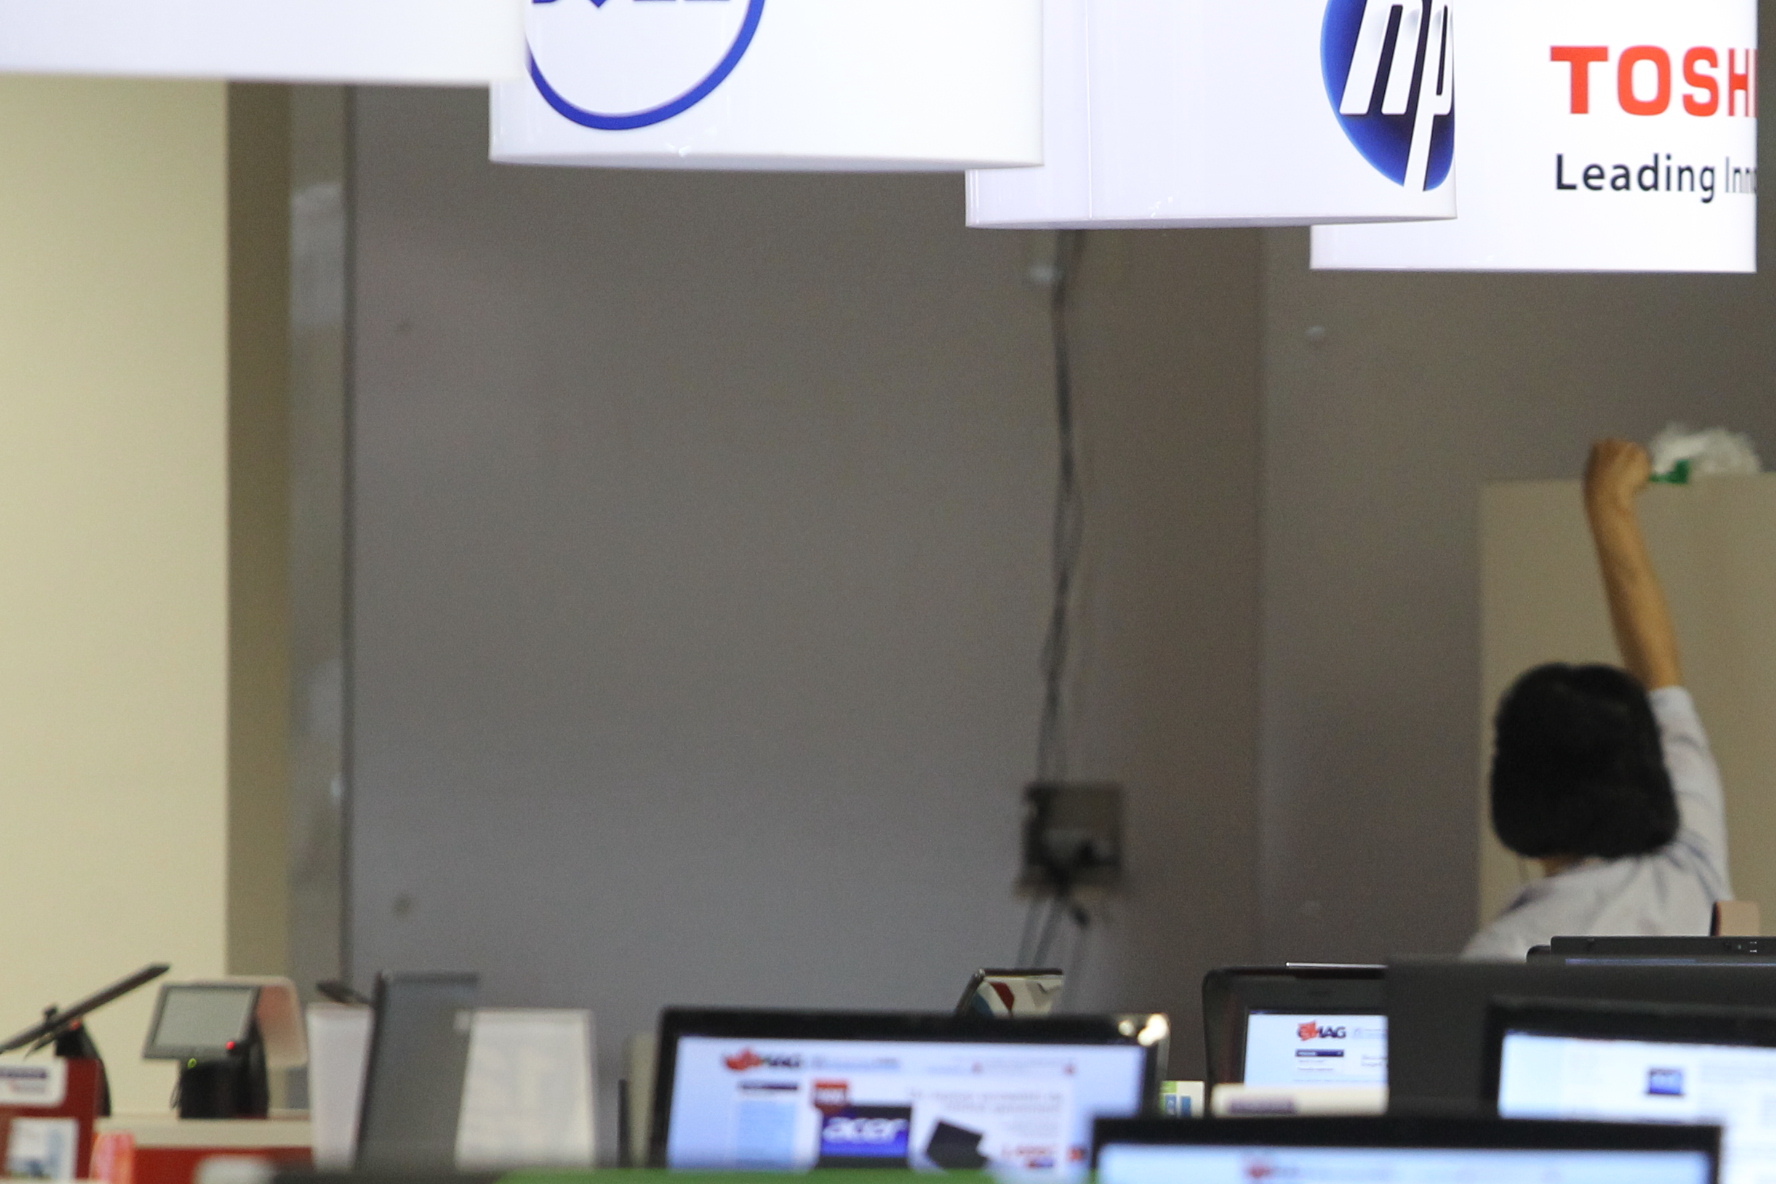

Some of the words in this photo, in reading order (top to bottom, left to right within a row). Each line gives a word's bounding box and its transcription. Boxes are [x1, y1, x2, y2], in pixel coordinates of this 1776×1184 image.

[1550, 45, 1757, 117] TOSH
[1556, 153, 1715, 203] Leading
[823, 1116, 908, 1143] acer
